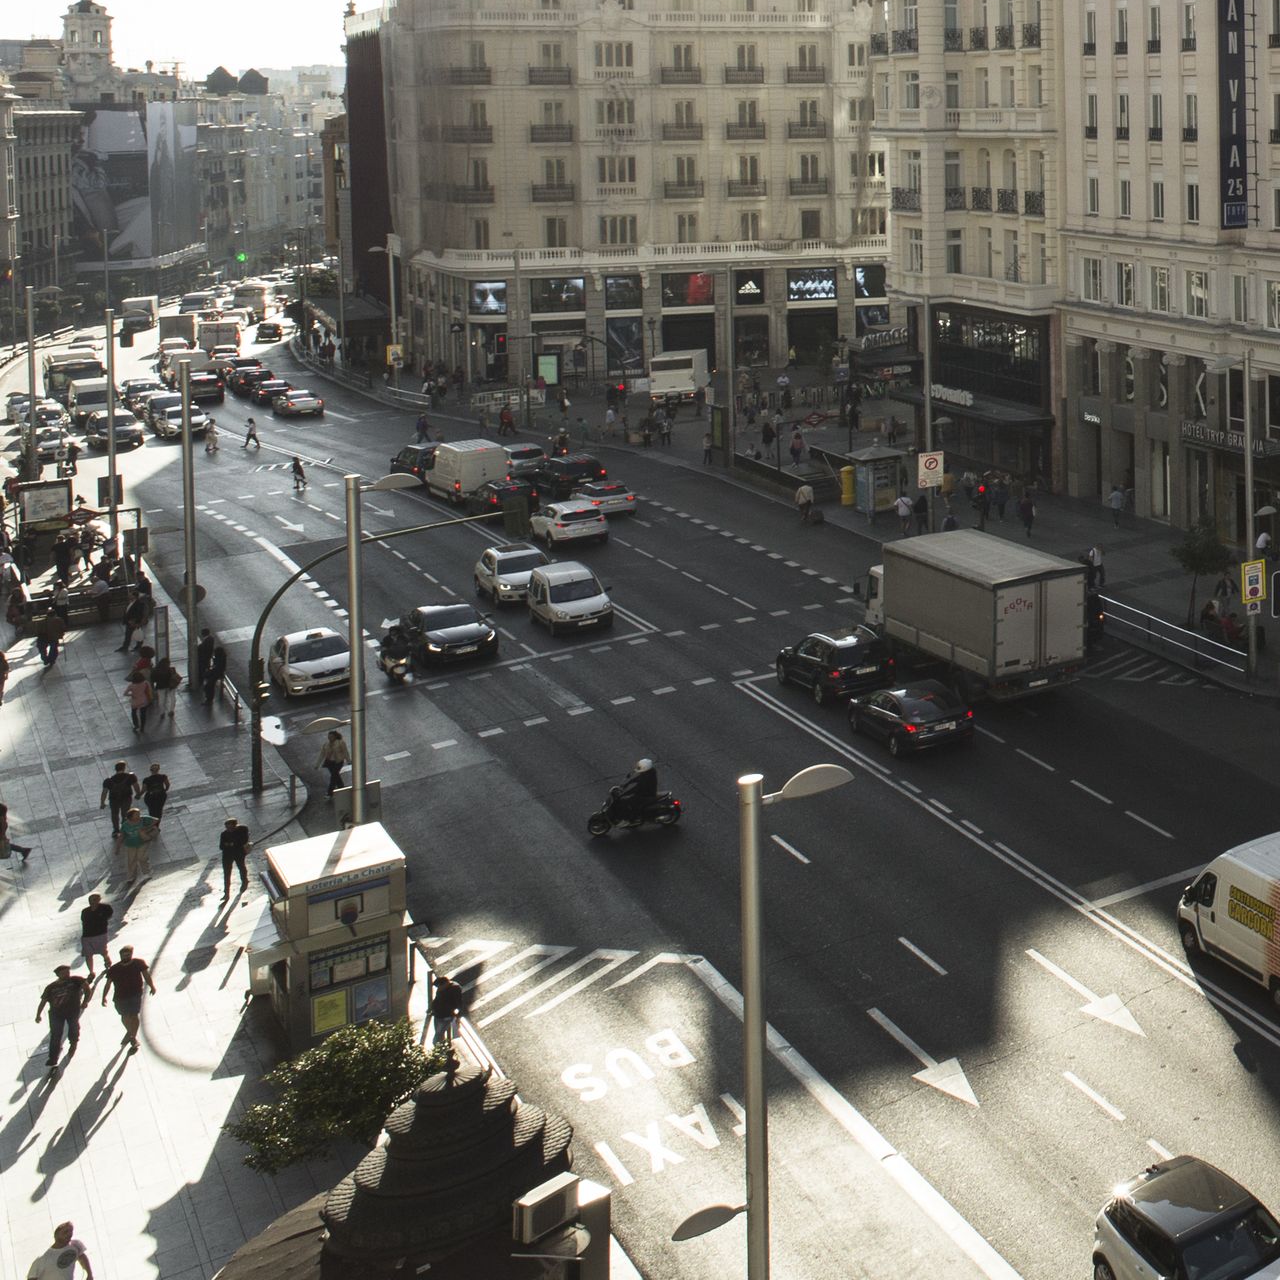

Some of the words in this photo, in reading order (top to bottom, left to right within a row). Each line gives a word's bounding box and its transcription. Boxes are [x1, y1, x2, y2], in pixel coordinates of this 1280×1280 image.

[1227, 177, 1244, 196] 25
[1182, 423, 1204, 439] HOTEL
[1206, 428, 1225, 444] TRYP
[1228, 899, 1275, 942] CARCOBA
[560, 1028, 697, 1102] BUS
